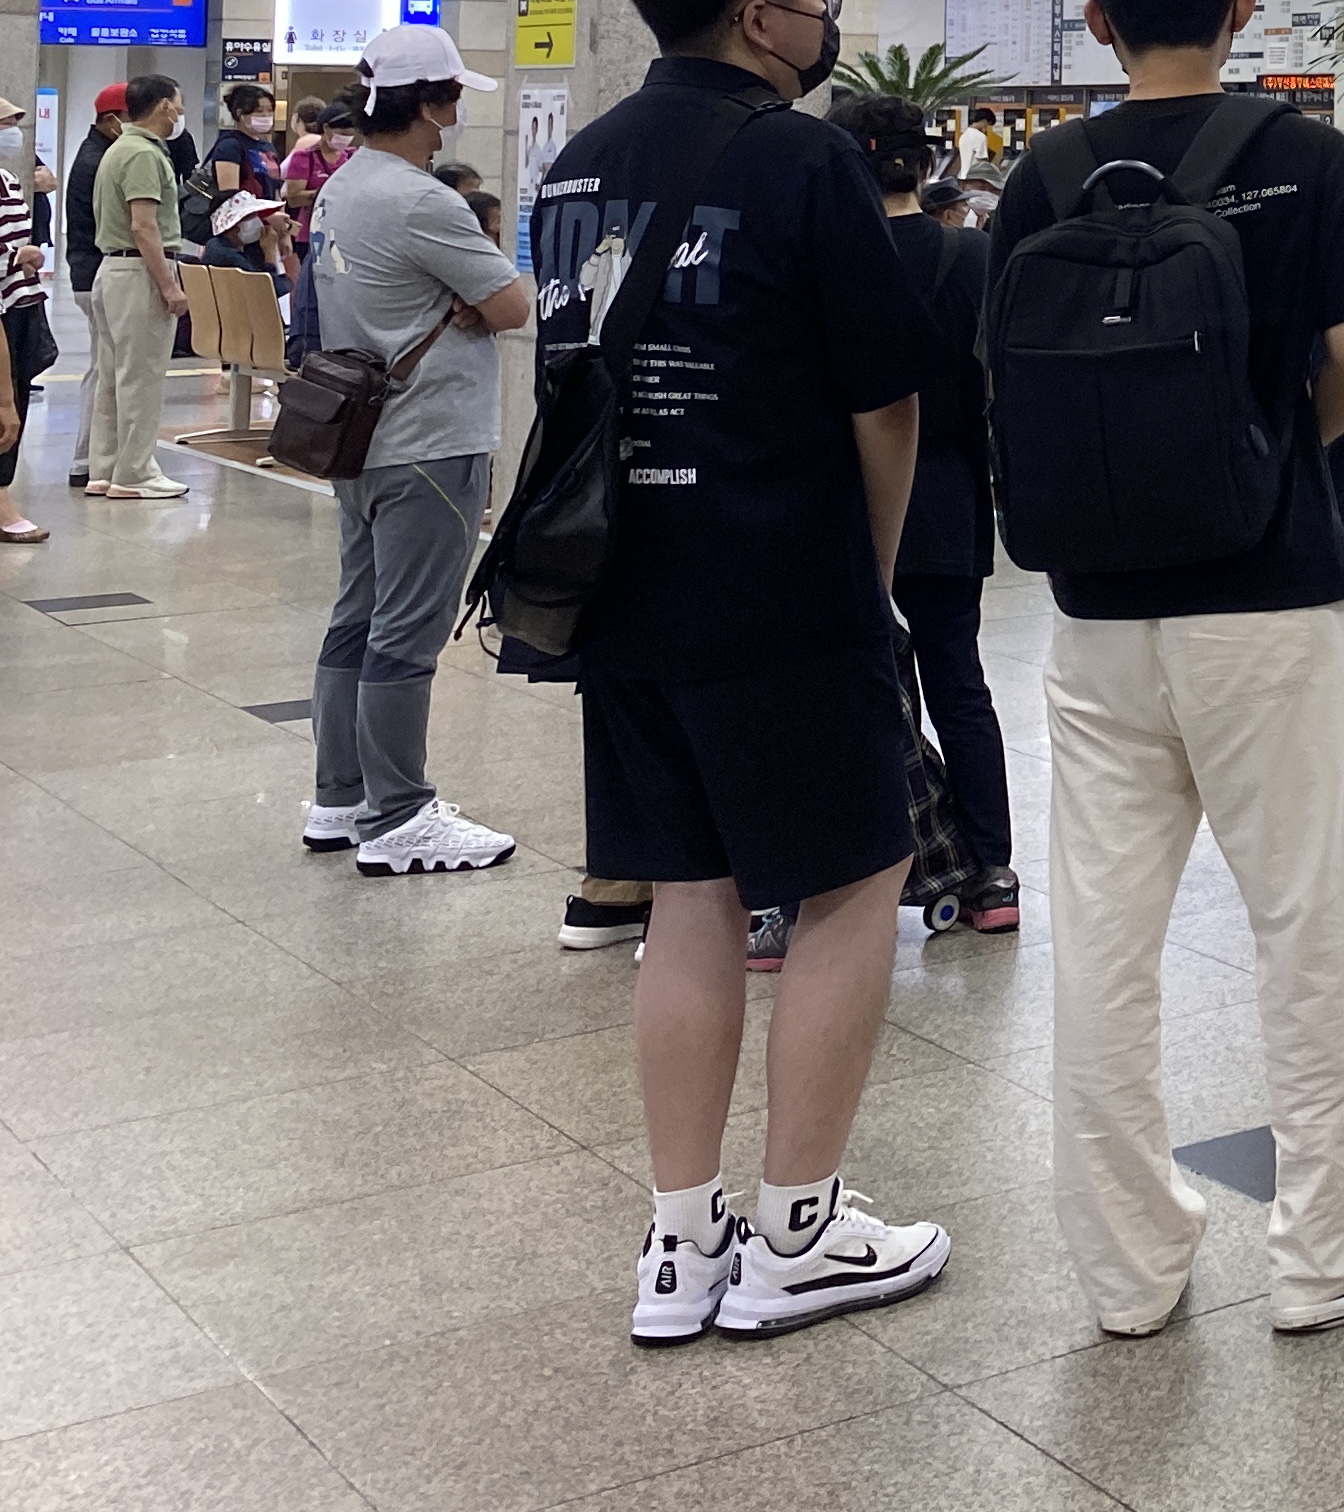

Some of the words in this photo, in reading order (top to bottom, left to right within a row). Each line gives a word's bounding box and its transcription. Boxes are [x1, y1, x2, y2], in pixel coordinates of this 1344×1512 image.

[224, 41, 271, 53] 유아수유실
[628, 467, 697, 485] ACCOMPLISH
[789, 1197, 819, 1231] C
[660, 1265, 673, 1287] AIR
